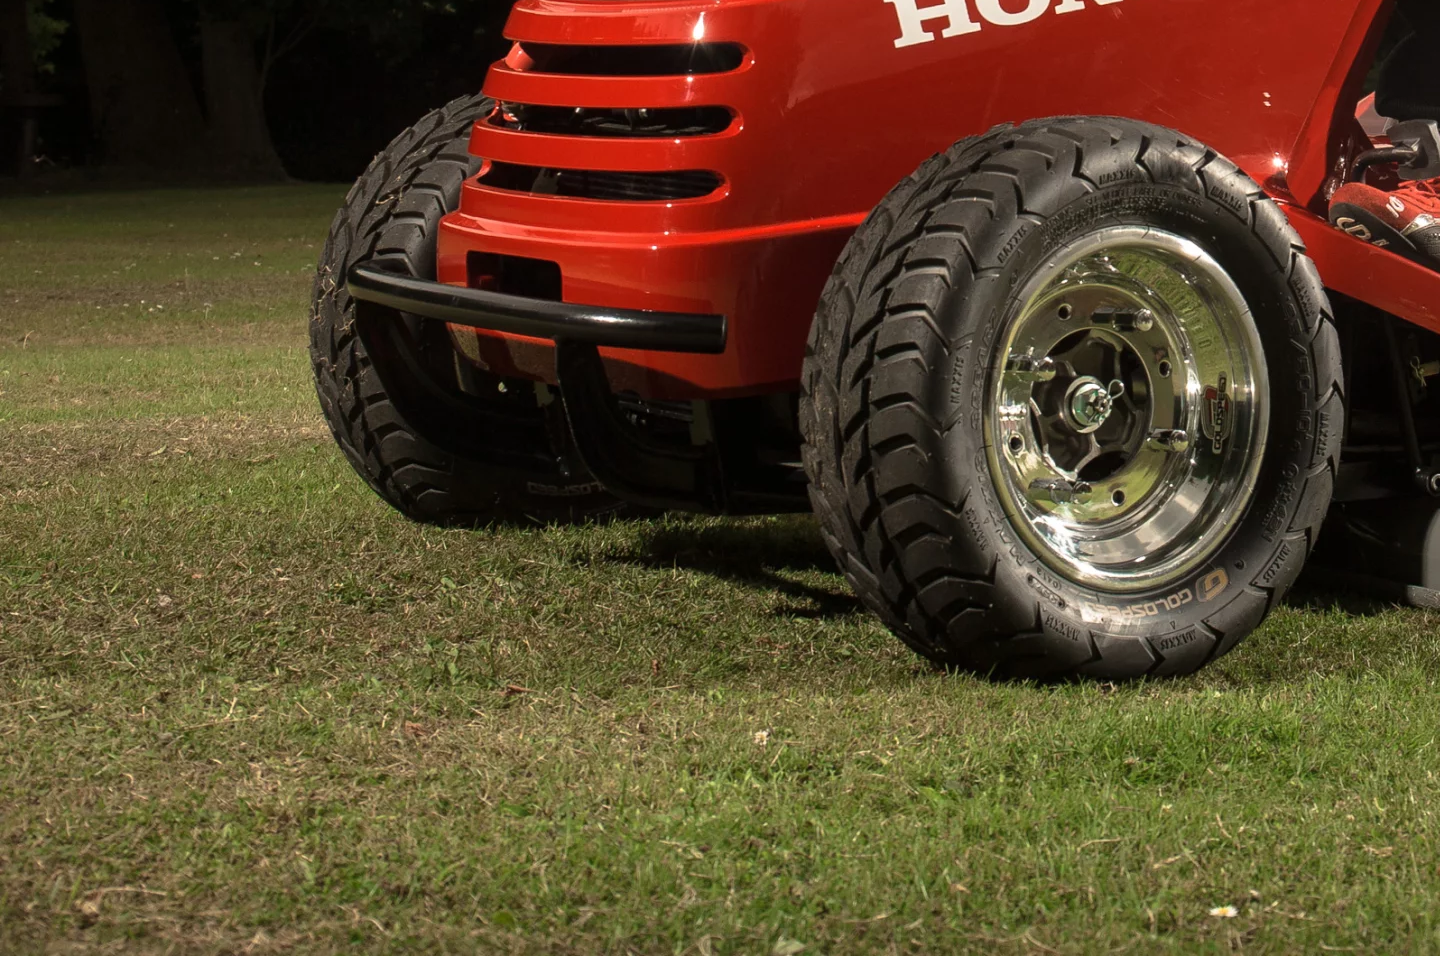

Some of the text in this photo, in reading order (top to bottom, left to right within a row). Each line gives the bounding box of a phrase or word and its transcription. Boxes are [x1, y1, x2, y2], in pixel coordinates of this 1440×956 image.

[997, 224, 1029, 264] MAXXIS
[950, 355, 965, 404] MAXXIS
[1316, 410, 1333, 457] MAXXIS
[1262, 545, 1293, 584] MAXXIS
[1084, 588, 1194, 619] GOLDSPEED
[1160, 627, 1198, 651] MAXXIS
